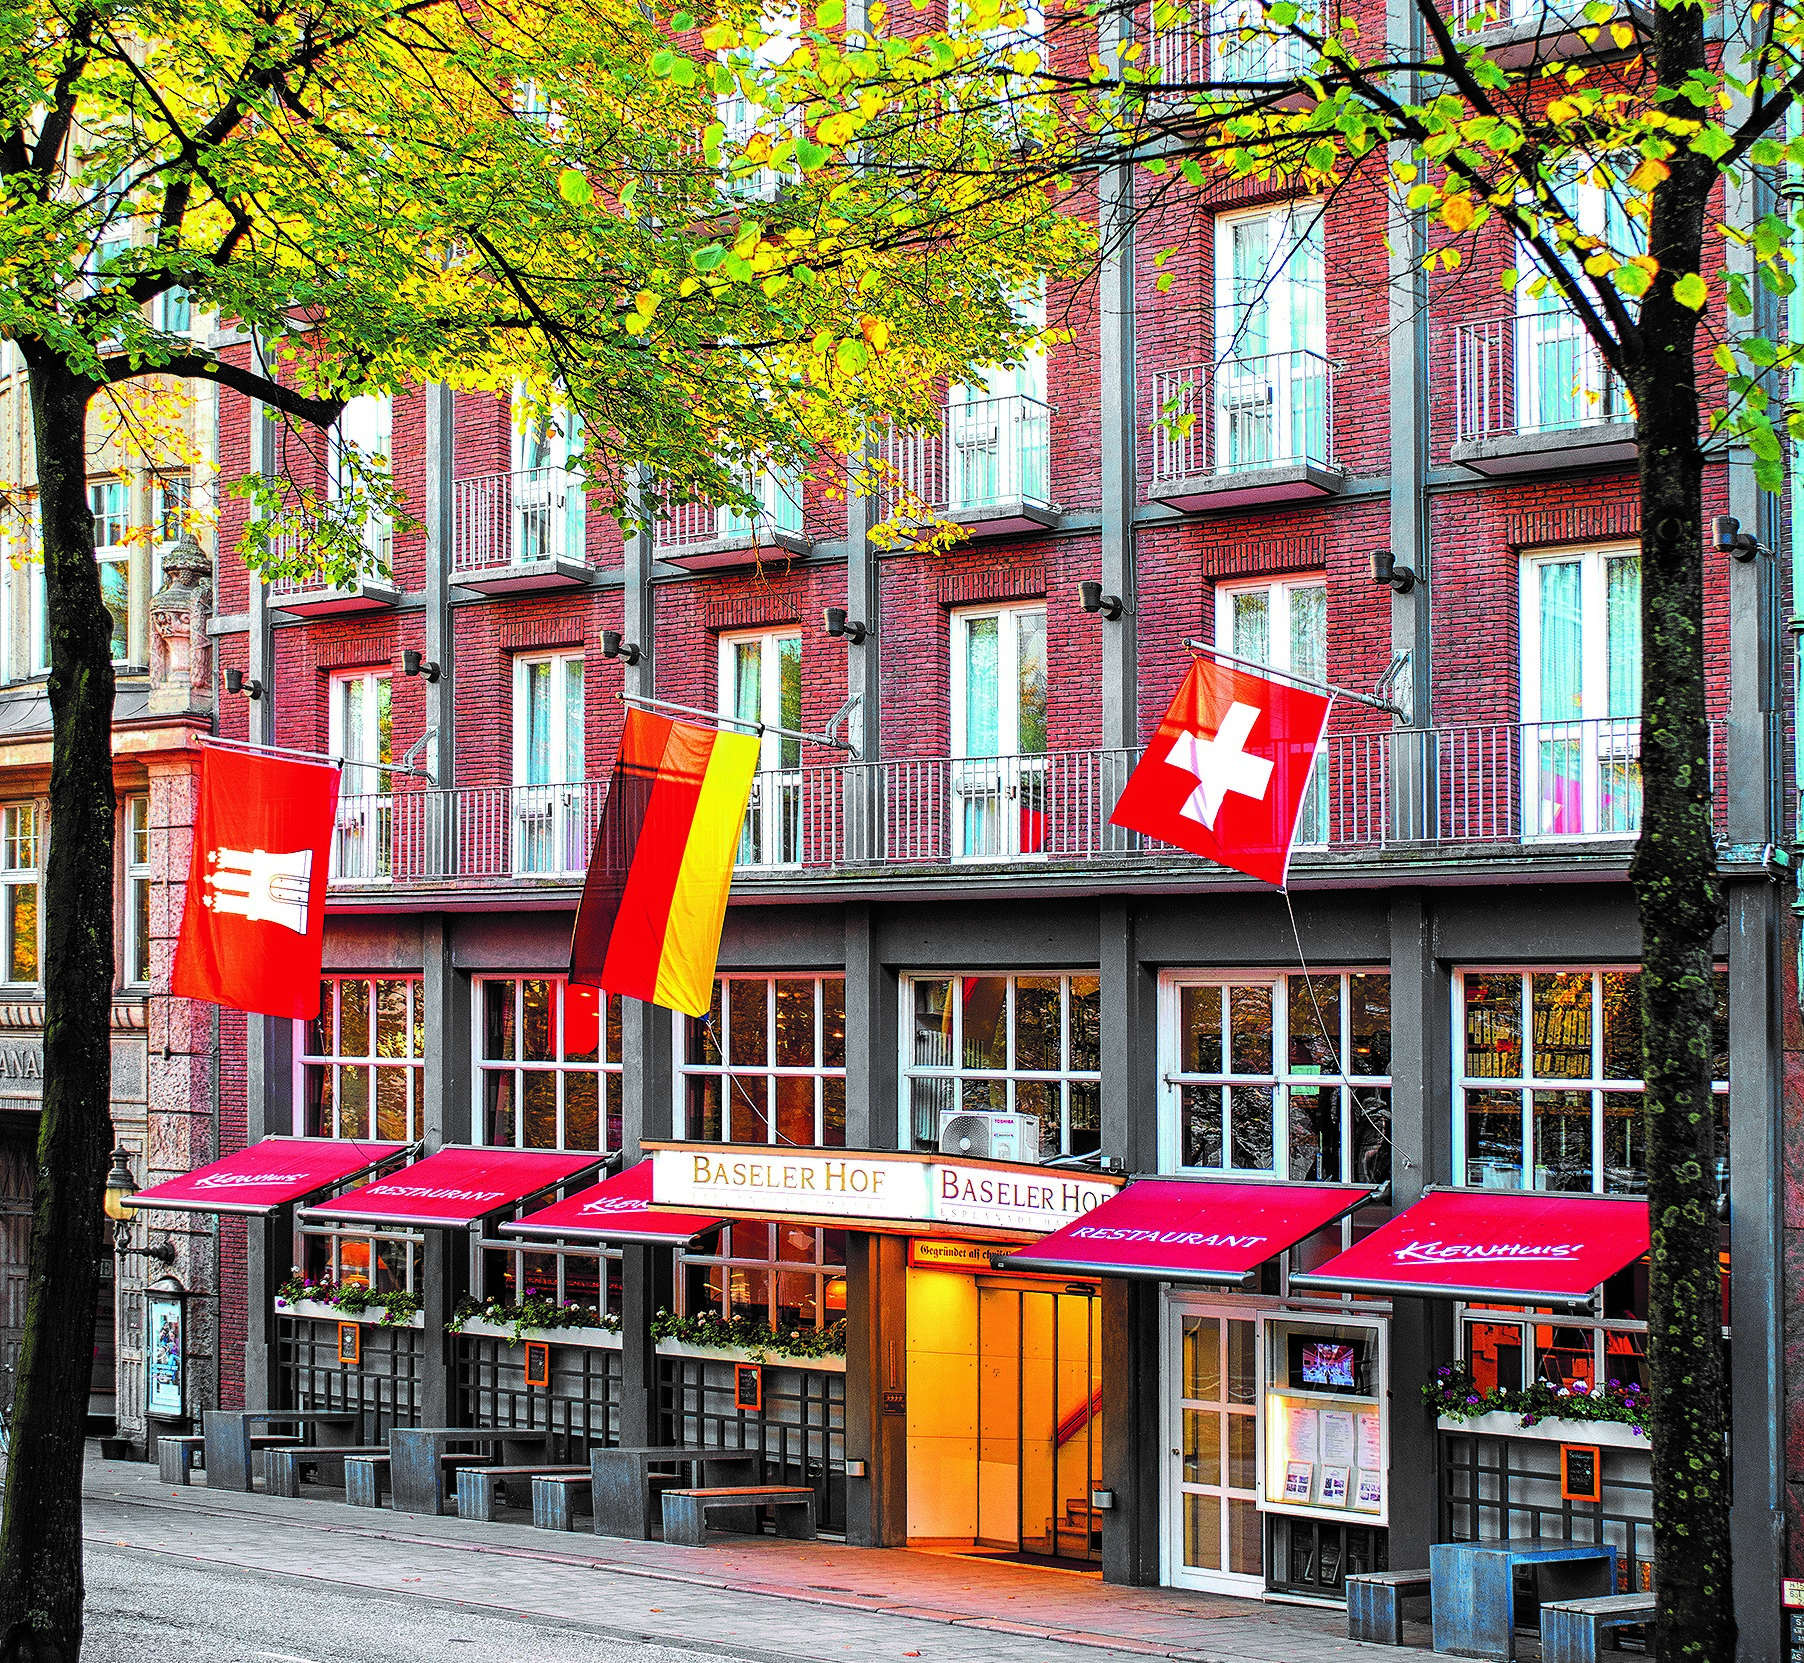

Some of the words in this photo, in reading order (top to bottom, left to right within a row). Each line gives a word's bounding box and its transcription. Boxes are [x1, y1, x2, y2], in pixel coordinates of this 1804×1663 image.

[693, 1155, 816, 1190] BASELER
[825, 1161, 886, 1194] HOF
[366, 1185, 505, 1202] RESTAURANT
[941, 1169, 1059, 1211] BASELER
[1069, 1226, 1267, 1248] RESTAURANT
[920, 1244, 966, 1258] Gegründet
